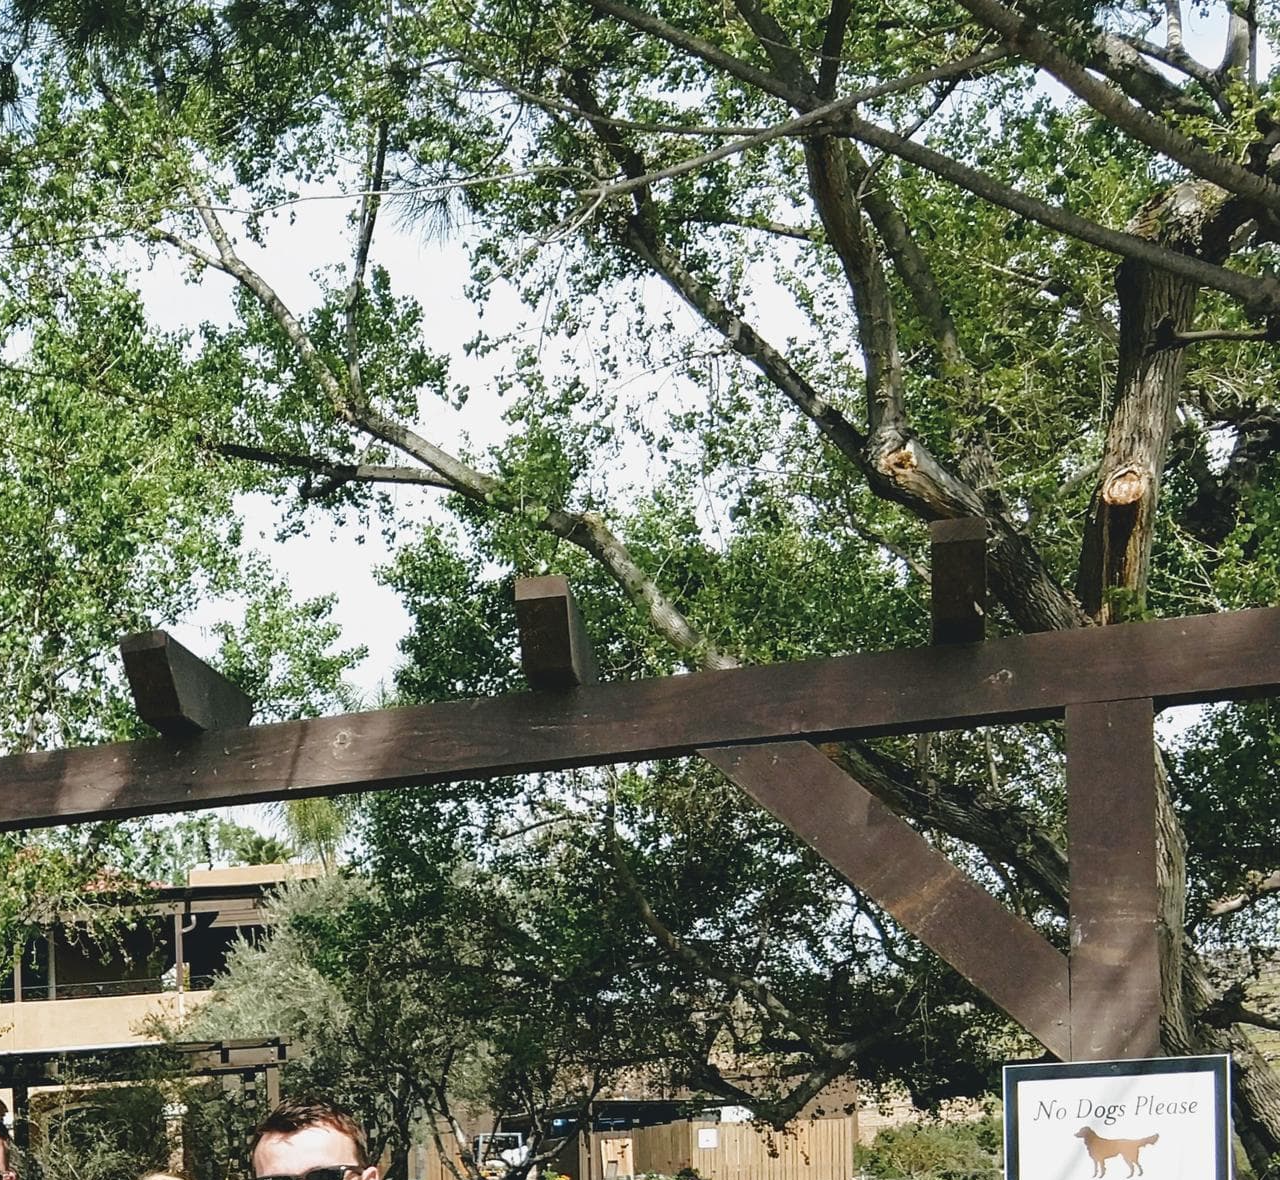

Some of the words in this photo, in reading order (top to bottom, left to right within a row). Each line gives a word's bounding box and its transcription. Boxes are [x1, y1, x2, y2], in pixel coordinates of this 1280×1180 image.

[1033, 1100, 1067, 1121] No
[1077, 1098, 1126, 1125] Dogs
[1134, 1095, 1198, 1116] Please
